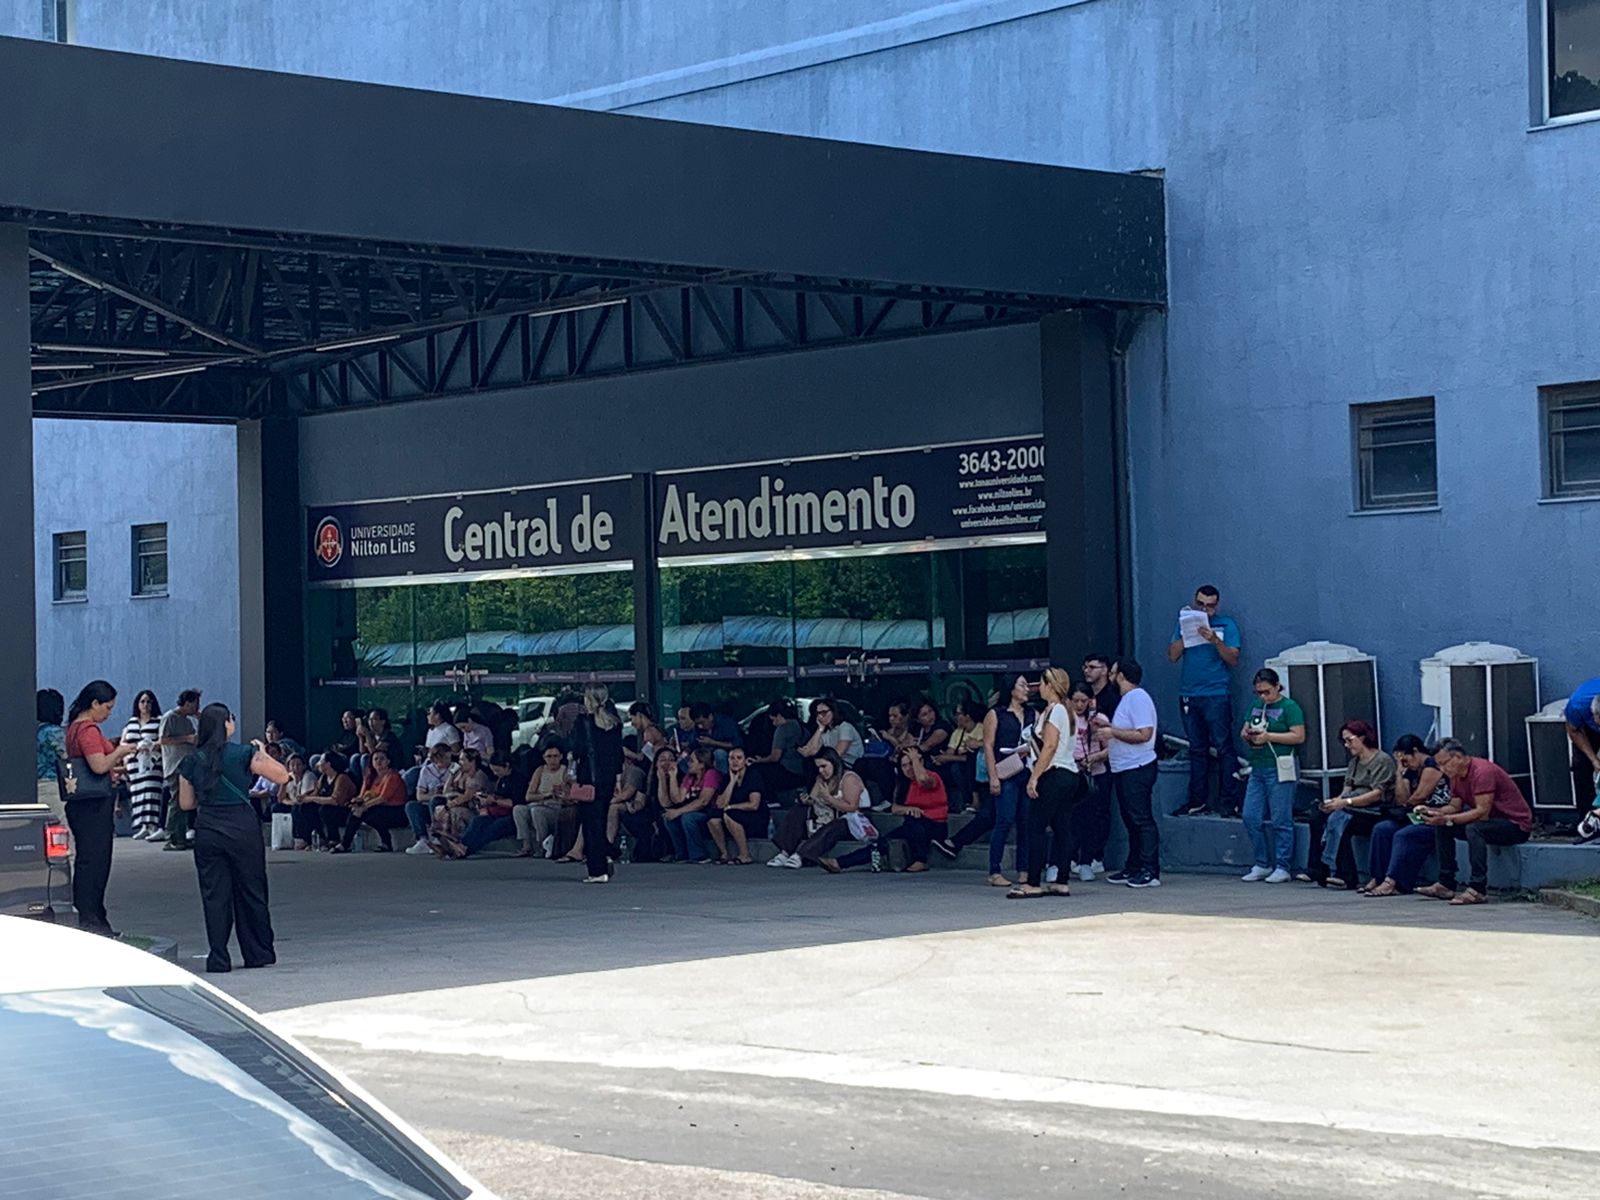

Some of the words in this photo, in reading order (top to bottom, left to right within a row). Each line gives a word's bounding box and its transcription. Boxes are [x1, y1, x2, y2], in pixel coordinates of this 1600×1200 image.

[444, 498, 561, 563] Central
[571, 494, 613, 553] de
[658, 476, 915, 545] Atendimento
[350, 522, 416, 540] UNIVERSIDADE
[351, 539, 387, 557] Nilton
[390, 538, 416, 554] Lins
